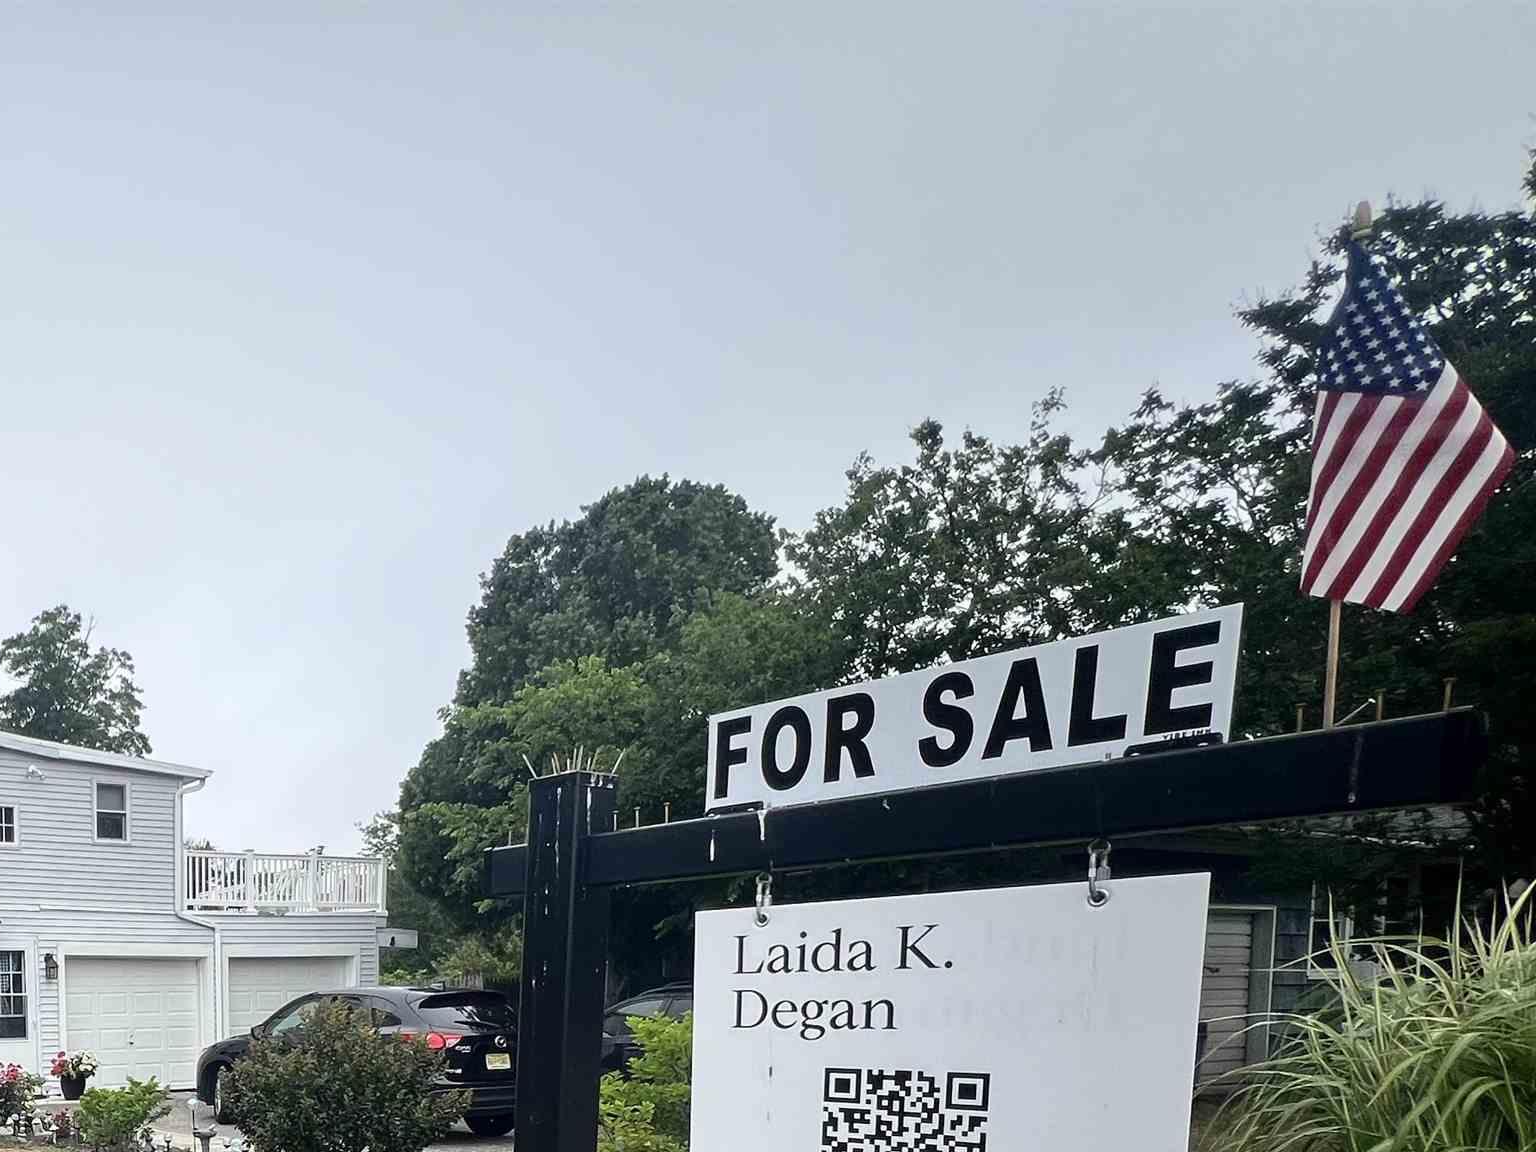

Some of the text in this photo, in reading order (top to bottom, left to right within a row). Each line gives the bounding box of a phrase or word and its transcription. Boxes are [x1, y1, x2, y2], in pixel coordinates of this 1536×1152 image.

[713, 620, 1222, 800] FOR SALE
[732, 924, 954, 976] Laida K.
[731, 988, 898, 1041] Degan
